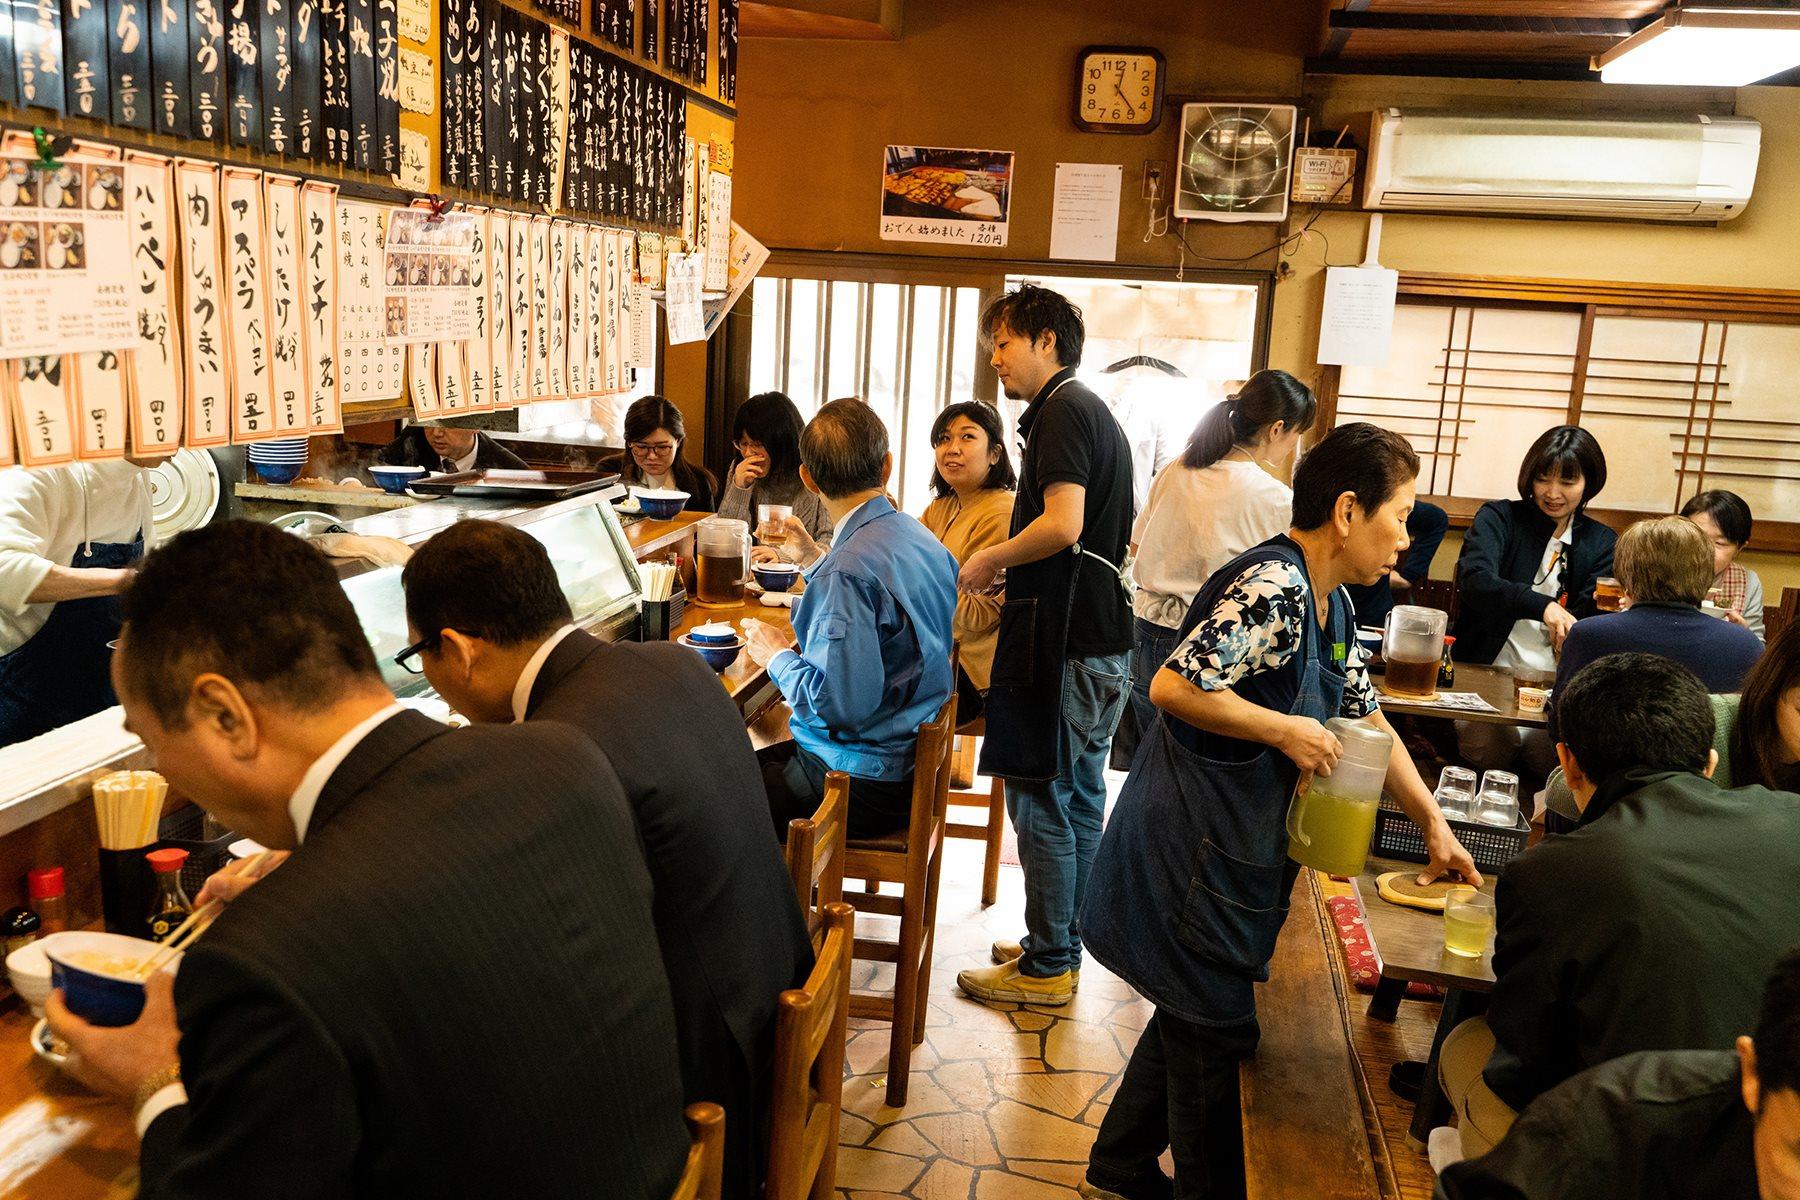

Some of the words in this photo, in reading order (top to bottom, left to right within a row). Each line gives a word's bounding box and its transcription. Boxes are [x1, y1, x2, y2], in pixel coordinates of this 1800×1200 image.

[1090, 68, 1101, 80] 10
[1103, 61, 1112, 71] 11
[1115, 60, 1127, 71] 12
[1133, 62, 1138, 72] 1
[1141, 70, 1150, 81] 2
[72, 61, 97, 114] 三五〇
[119, 74, 139, 122] 三〇〇
[161, 81, 179, 128] 三〇〇
[1087, 83, 1096, 95] 9
[1087, 99, 1096, 110] 8
[1141, 86, 1150, 97] 3
[198, 92, 218, 138] 三〇〇
[234, 94, 253, 138] 三〇〇
[1098, 108, 1106, 118] 7
[1112, 109, 1120, 120] 6
[1139, 101, 1148, 112] 4
[269, 106, 289, 153] 三五〇
[299, 108, 312, 154] 三〇〇
[357, 123, 371, 165] 三〇〇
[448, 154, 461, 185] 五五〇
[469, 154, 480, 186] 五五〇
[488, 155, 499, 191] 五〇〇
[505, 160, 515, 192] 五〇〇
[520, 168, 532, 200] 五〇〇
[135, 184, 166, 295] ハンペン
[340, 207, 354, 268] 手羽焼
[884, 223, 965, 238] おでん始めました
[970, 233, 1002, 246] 120円
[978, 223, 997, 233] 各種
[231, 199, 256, 310] アスパラ
[275, 202, 292, 330] しいたけ
[359, 214, 370, 289] つくね焼
[309, 210, 329, 343] ウインナー
[471, 370, 484, 403] 五五〇
[493, 366, 503, 402] 五五〇
[149, 400, 165, 442] 四〇〇
[201, 396, 215, 433] 四〇〇
[243, 392, 265, 431] 四五〇
[283, 390, 296, 426] 四〇〇
